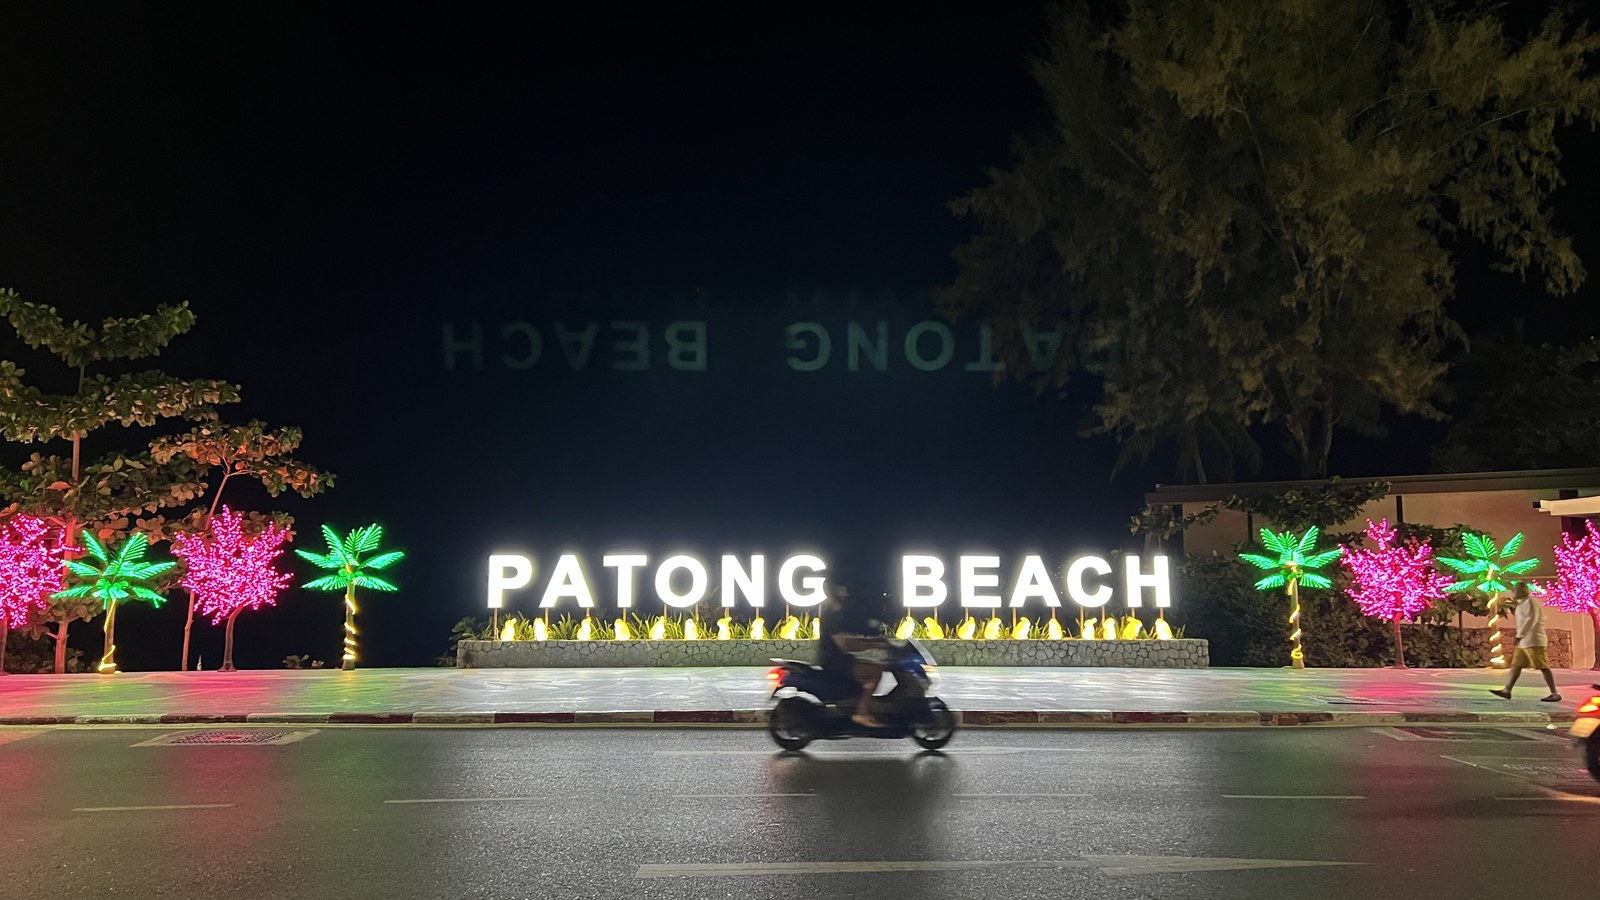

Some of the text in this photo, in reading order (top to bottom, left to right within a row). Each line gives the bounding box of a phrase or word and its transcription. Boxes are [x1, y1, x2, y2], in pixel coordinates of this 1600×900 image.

[441, 319, 708, 372] BEACH
[487, 554, 1171, 609] PATONG BEACH
